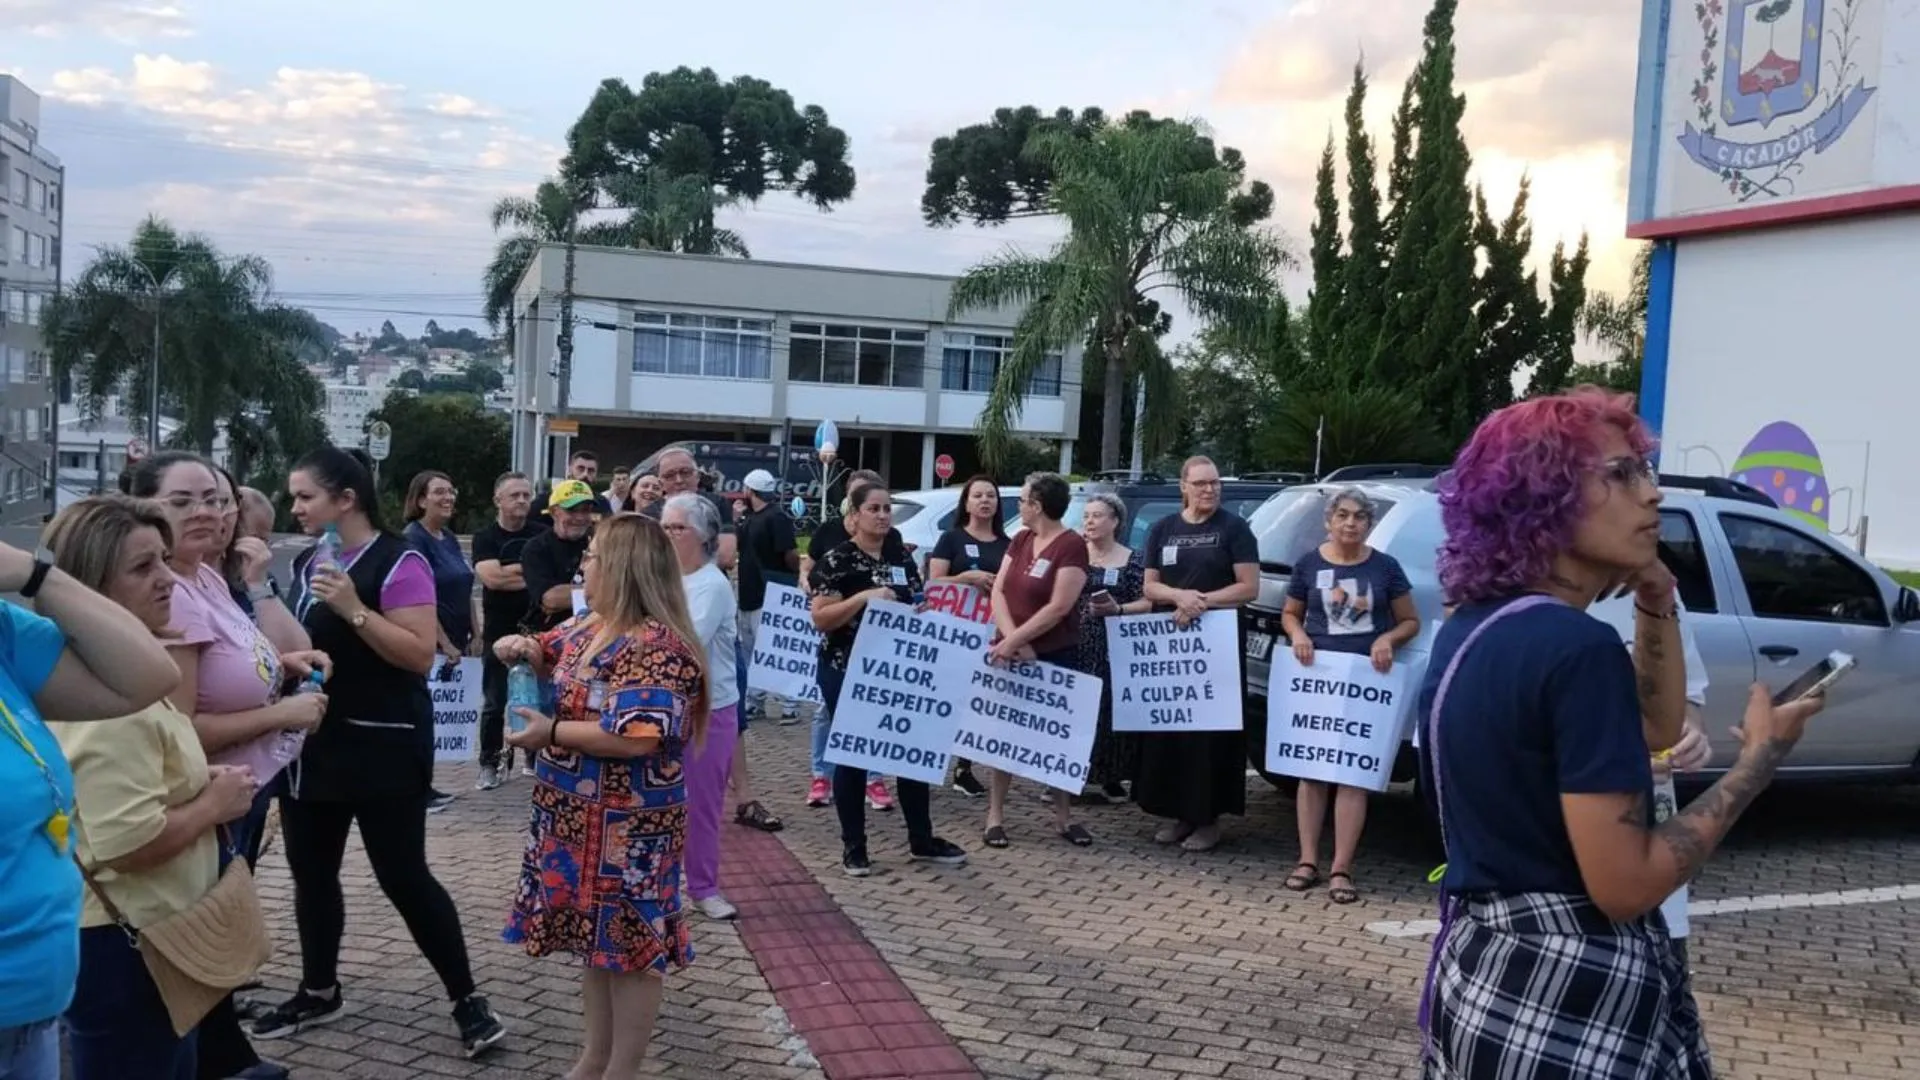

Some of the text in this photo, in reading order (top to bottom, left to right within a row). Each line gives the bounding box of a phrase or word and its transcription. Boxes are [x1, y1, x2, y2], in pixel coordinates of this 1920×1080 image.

[868, 608, 982, 650] TRABALHO
[893, 638, 939, 664] TEM
[1133, 640, 1158, 656] NA
[862, 657, 936, 692] VALOR,
[983, 651, 1077, 690] CEGA DE
[1130, 659, 1207, 678] PREFEITO
[851, 683, 952, 718] RESPEITO
[1121, 680, 1214, 703] A CULPA É
[1290, 677, 1393, 706] SERVIDOR
[878, 713, 911, 734] AO
[970, 697, 1071, 739] QUEREMOS
[1150, 707, 1193, 725] SUA!
[1291, 713, 1373, 739] MERECE
[828, 731, 946, 769] SERVIDOR!
[1278, 742, 1380, 772] RESPEITO!
